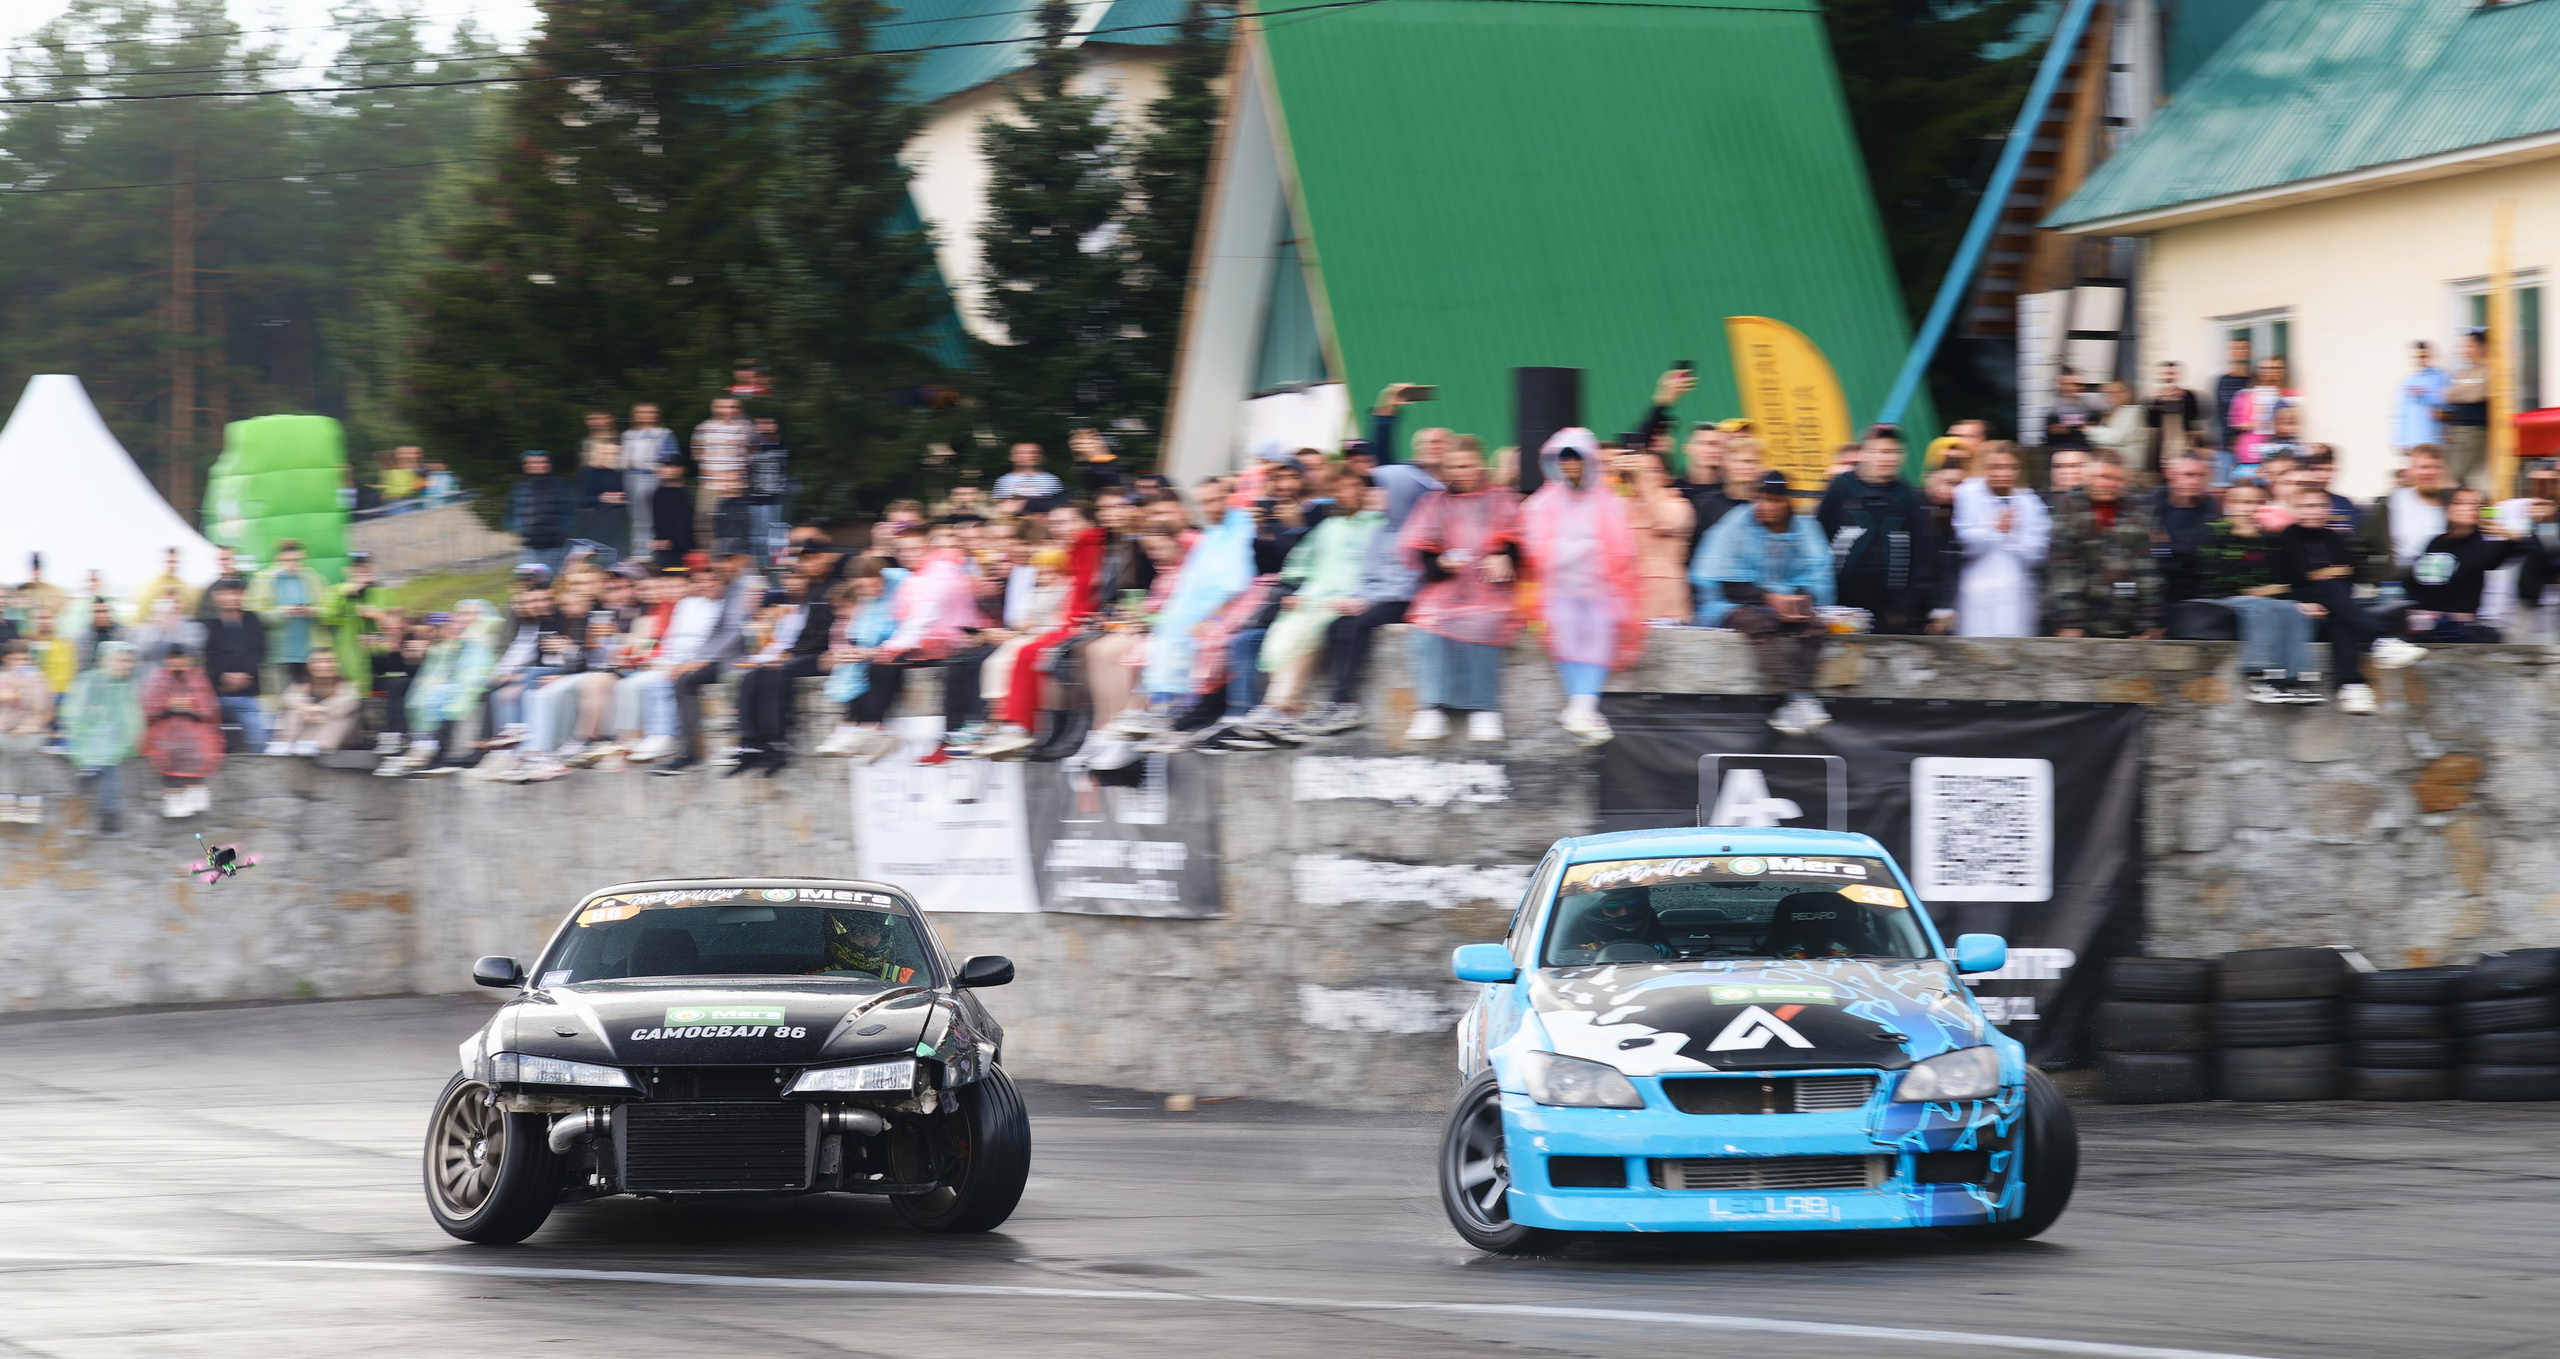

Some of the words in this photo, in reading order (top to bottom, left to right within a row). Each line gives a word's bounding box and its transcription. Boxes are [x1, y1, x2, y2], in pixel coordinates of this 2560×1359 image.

[1767, 857, 1867, 876] Мега
[799, 888, 892, 905] Мега
[1861, 887, 1897, 905] 33
[591, 907, 622, 922] 86
[711, 1009, 782, 1018] Мега
[630, 1026, 769, 1041] САМОСВАЛ
[773, 1026, 807, 1039] 86
